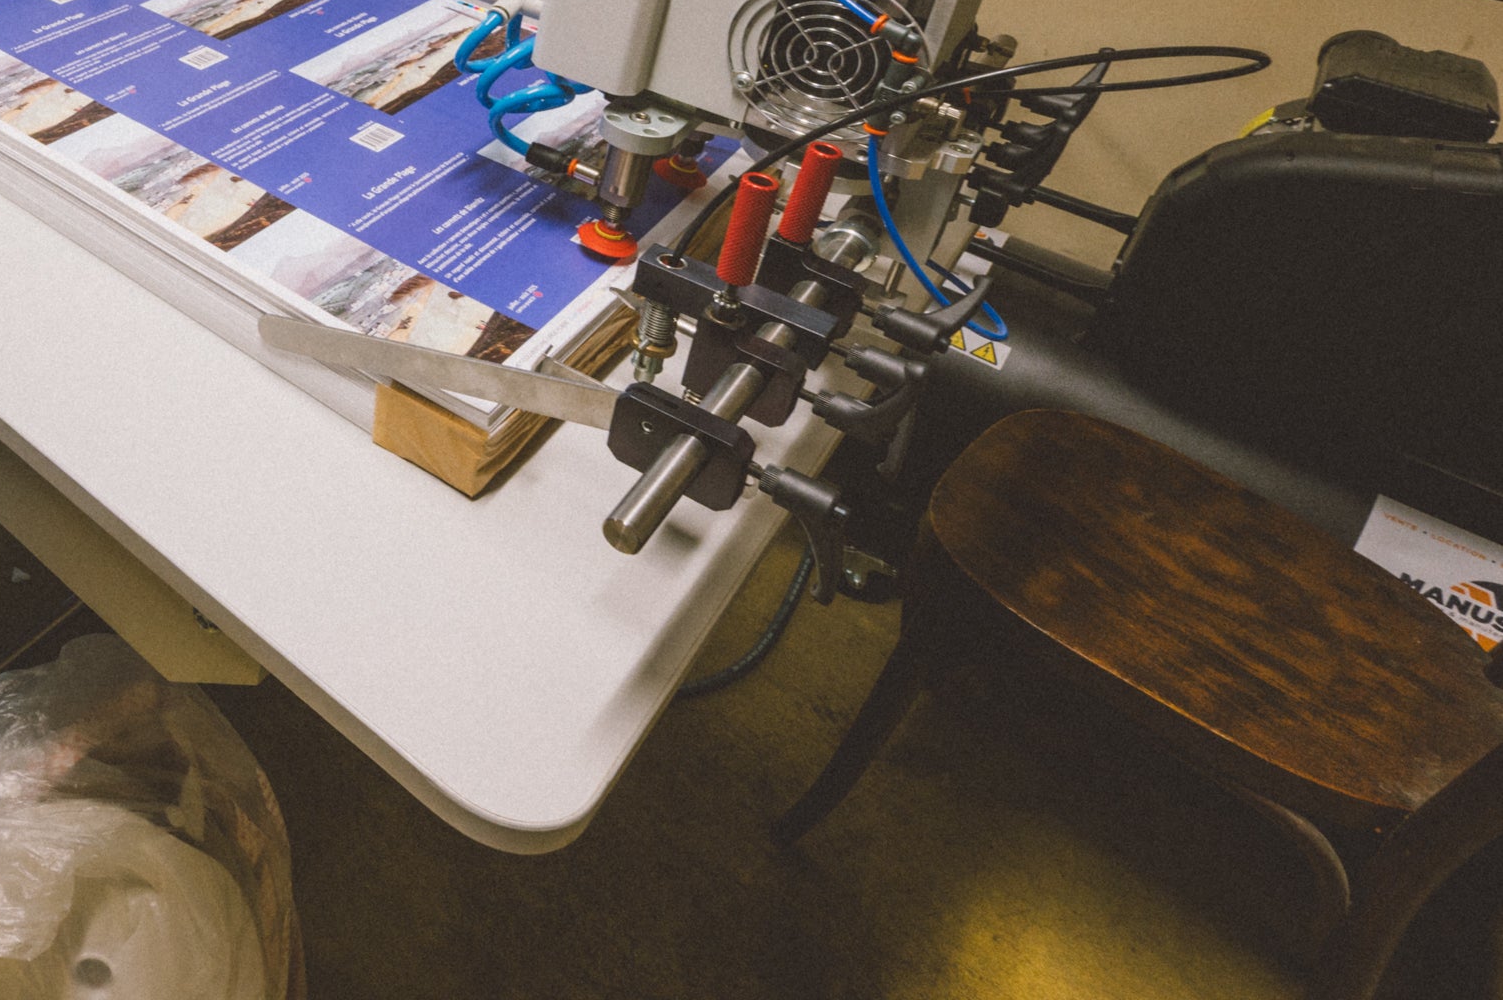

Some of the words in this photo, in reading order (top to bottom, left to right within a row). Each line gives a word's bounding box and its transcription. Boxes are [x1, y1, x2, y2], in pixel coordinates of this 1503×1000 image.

[186, 87, 213, 104] Grande
[210, 79, 232, 92] Plage
[371, 175, 398, 195] Grande
[394, 164, 417, 180] Plage
[441, 213, 462, 230] carnets
[464, 196, 485, 212] Biarritz
[1383, 511, 1419, 531] VENTE
